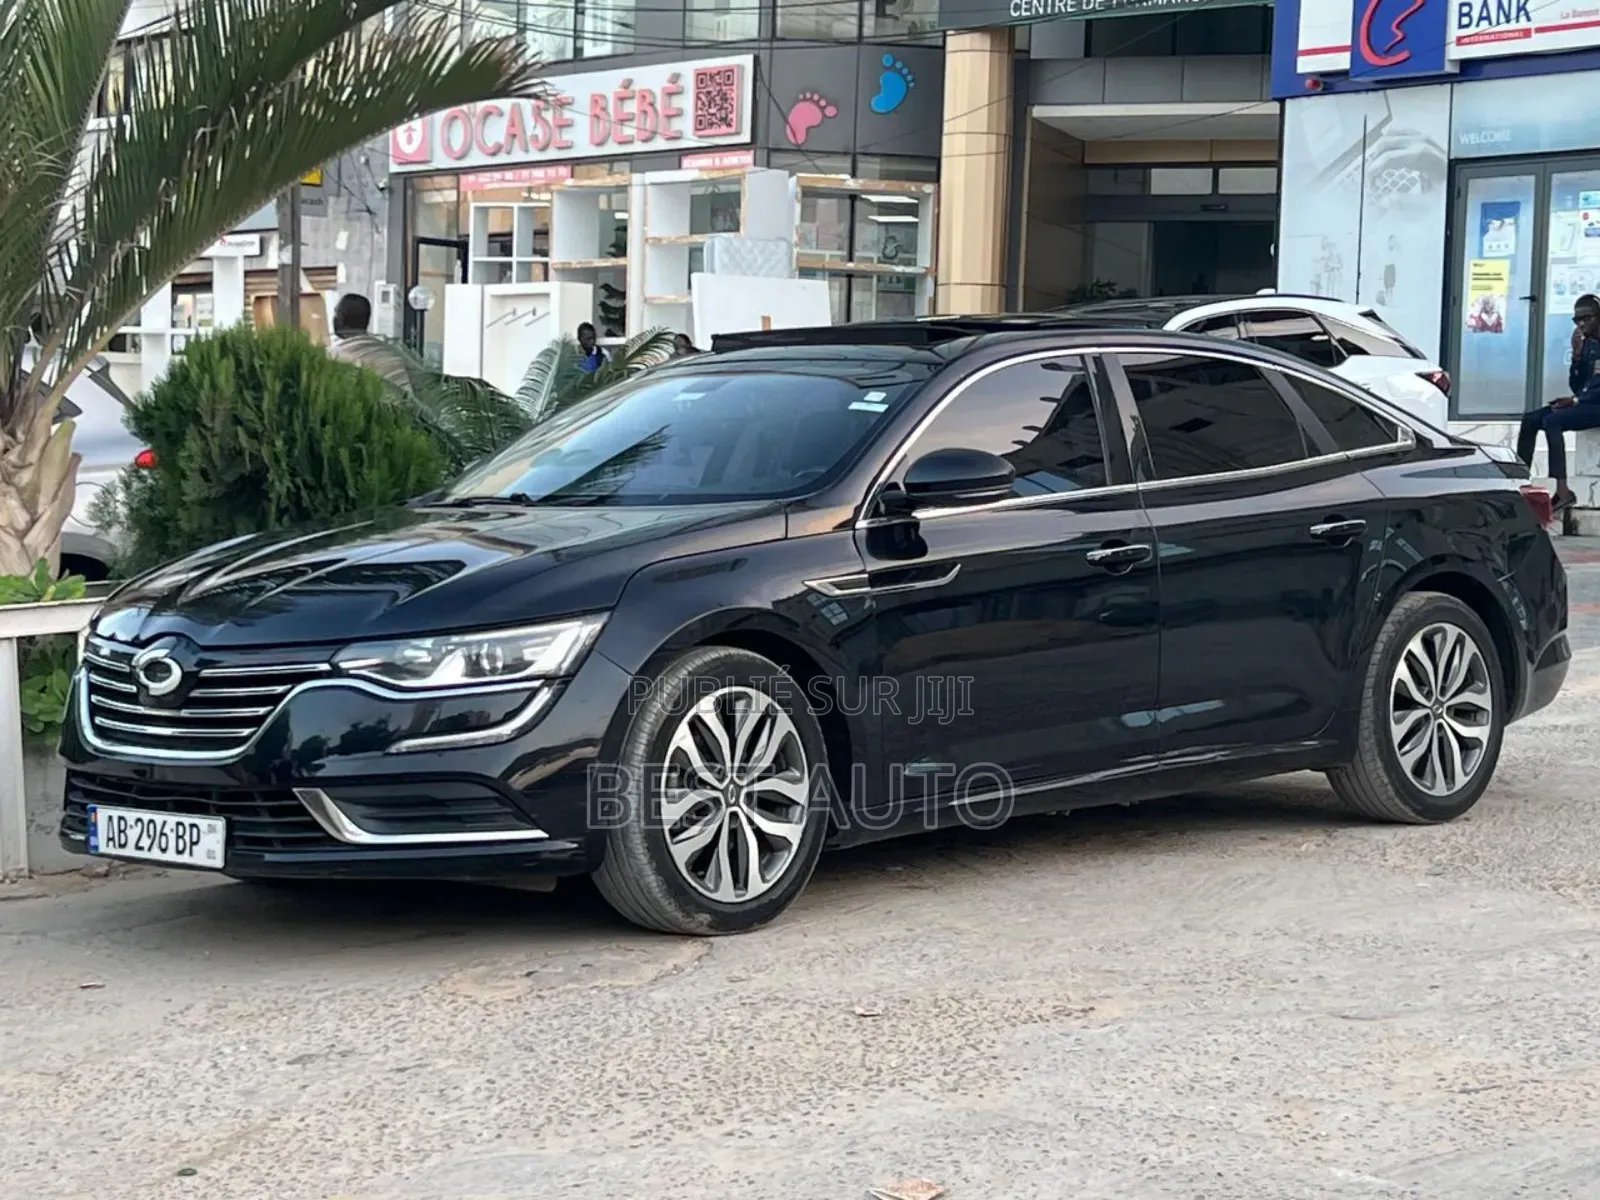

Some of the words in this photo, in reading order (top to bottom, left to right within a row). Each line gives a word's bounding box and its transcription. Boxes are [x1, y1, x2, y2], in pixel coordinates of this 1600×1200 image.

[1010, 0, 1077, 17] CENTRE
[1457, 0, 1532, 29] BANK
[589, 72, 683, 147] BÉBÉ
